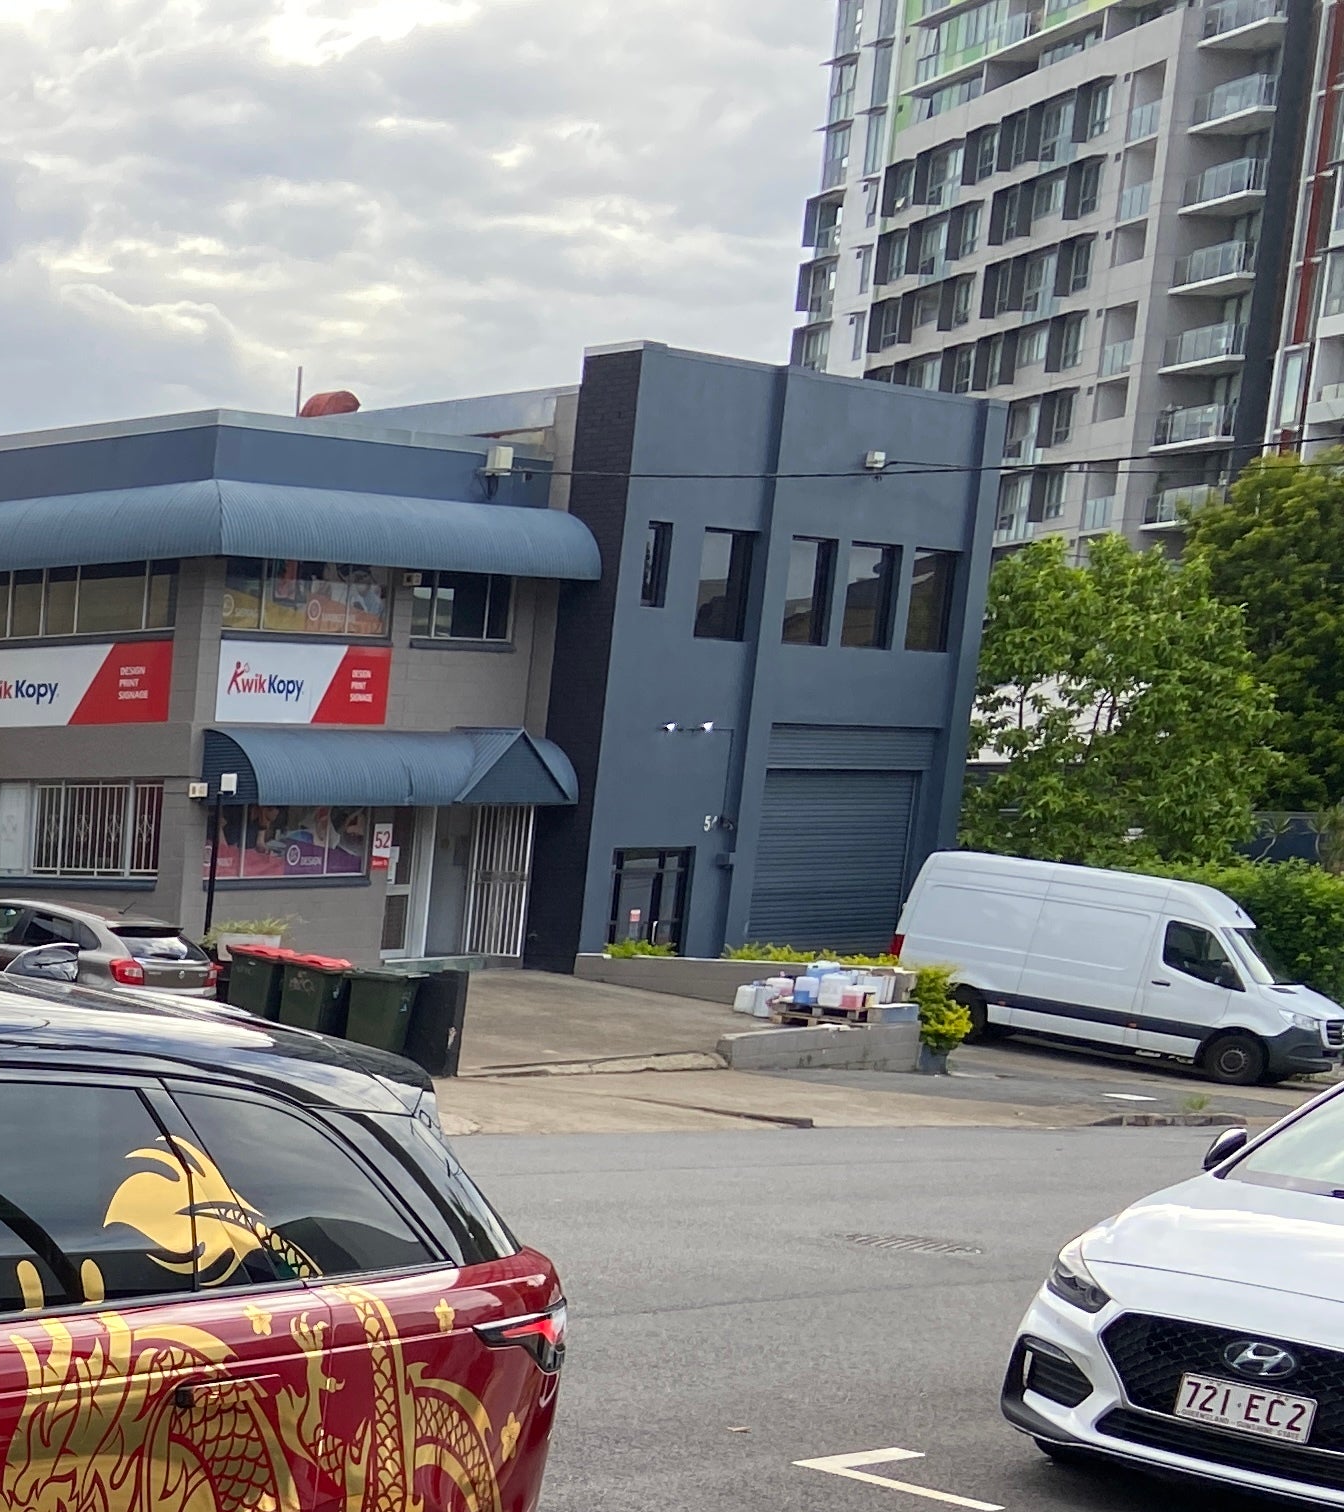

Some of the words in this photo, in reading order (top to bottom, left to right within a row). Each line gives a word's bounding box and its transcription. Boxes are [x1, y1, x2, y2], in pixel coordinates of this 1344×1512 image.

[375, 831, 392, 849] 52
[1185, 1381, 1231, 1416] 721
[1244, 1393, 1307, 1432] EC2
